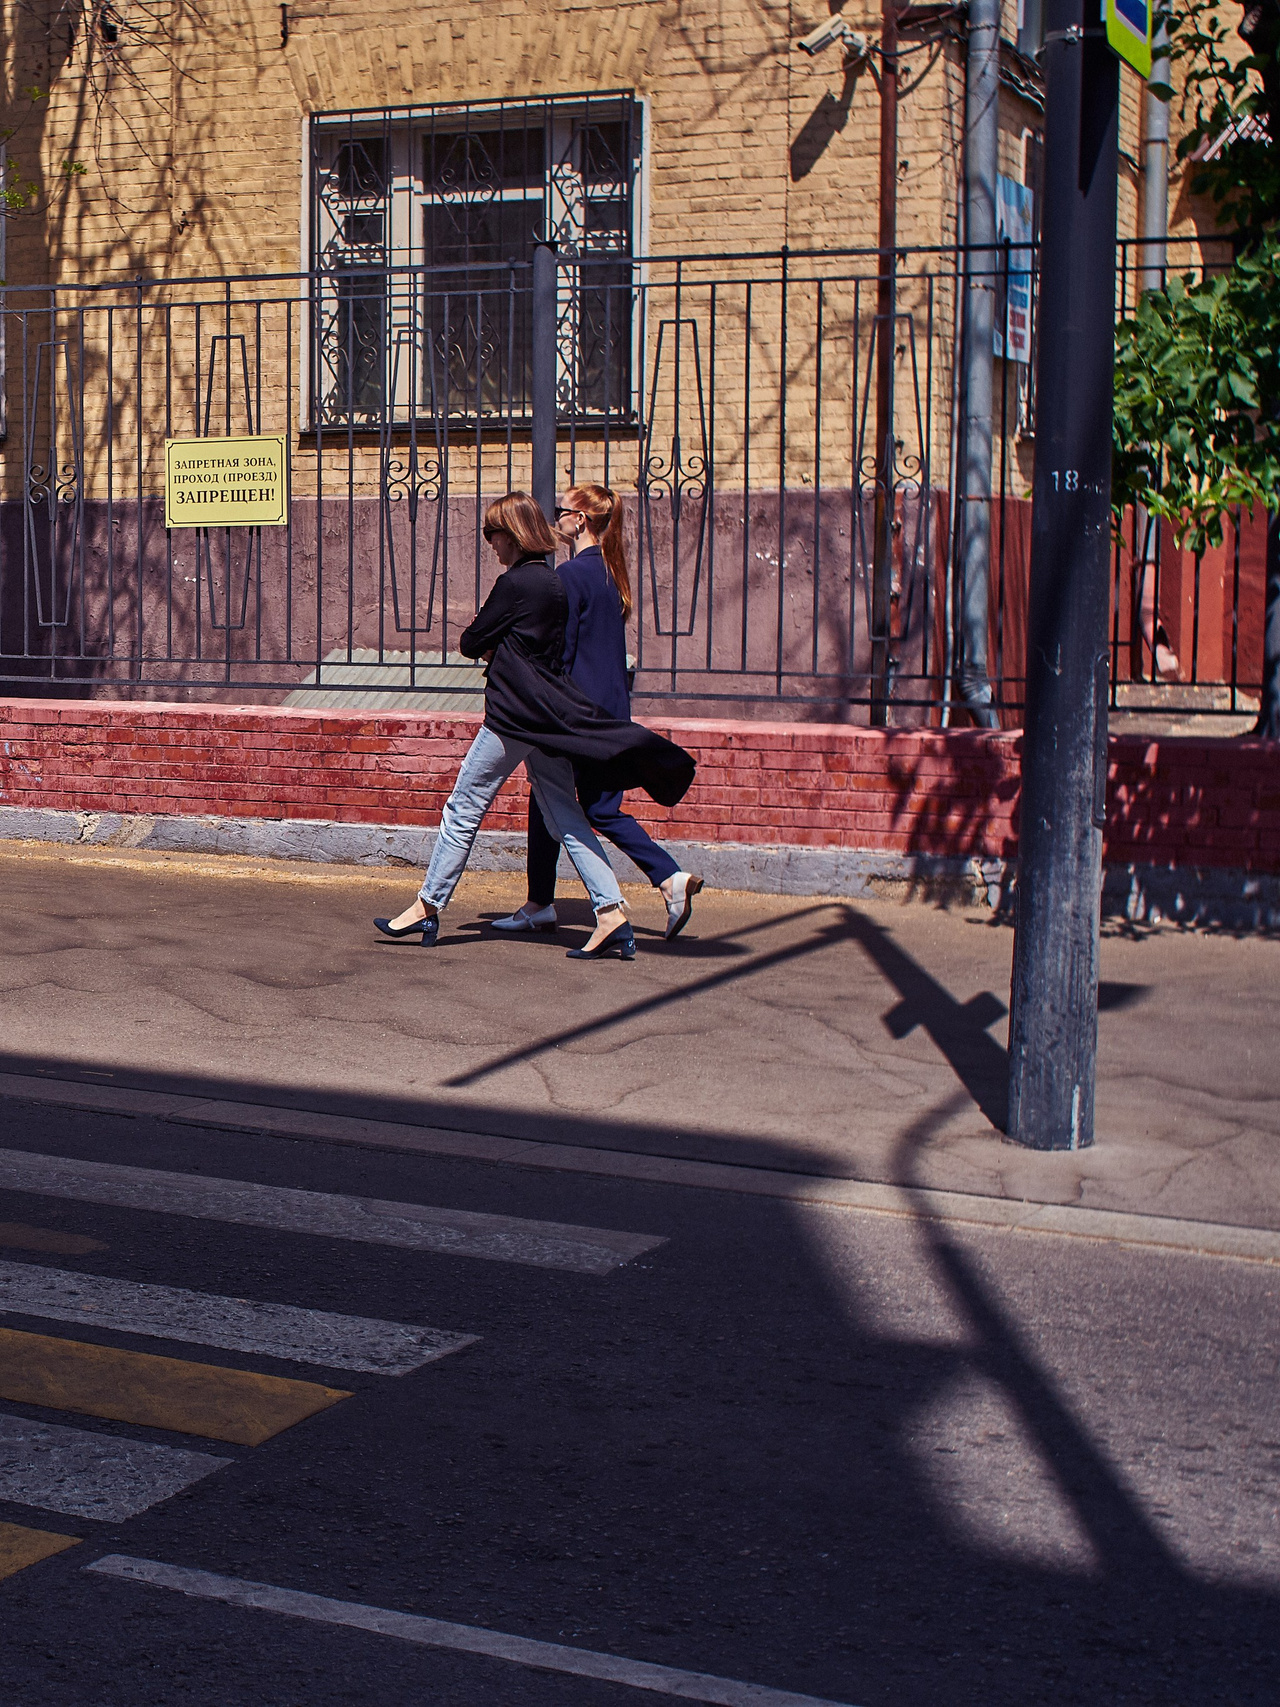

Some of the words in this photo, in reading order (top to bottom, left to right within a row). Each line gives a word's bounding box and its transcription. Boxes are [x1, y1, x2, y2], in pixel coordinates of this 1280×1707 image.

[174, 458, 239, 469] ЗАПРЕТНАЯ
[243, 457, 276, 467] ЗОНА,
[173, 473, 219, 484] ПРОХОД
[223, 471, 277, 483] (ПРОЕЗД)
[176, 488, 275, 504] ЗАПРЕЩЕН!
